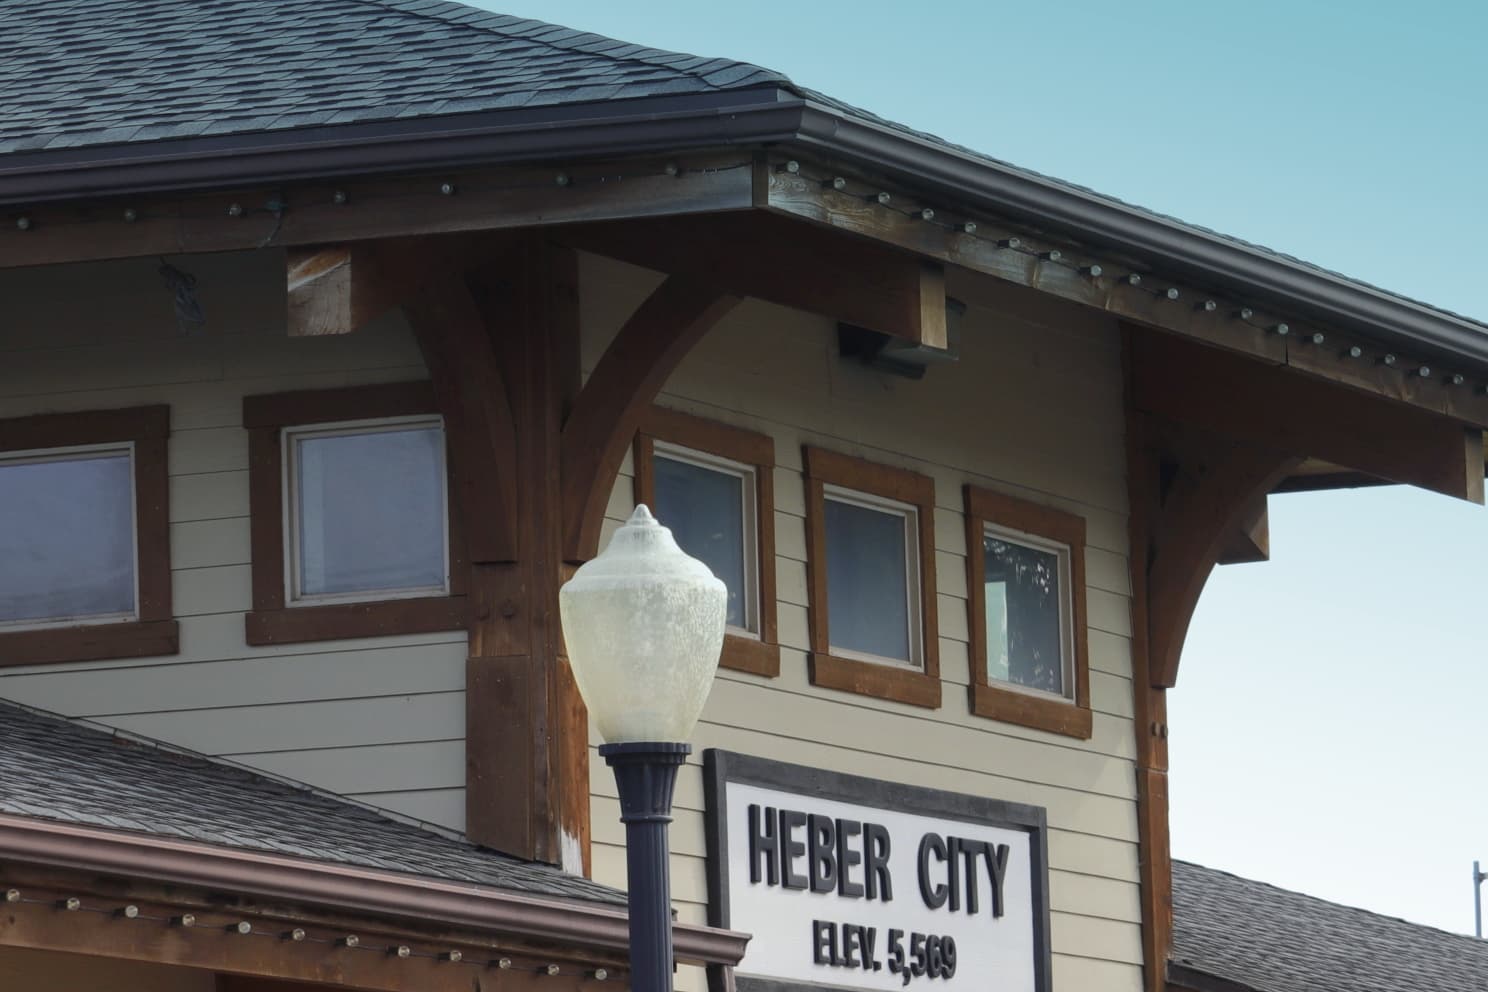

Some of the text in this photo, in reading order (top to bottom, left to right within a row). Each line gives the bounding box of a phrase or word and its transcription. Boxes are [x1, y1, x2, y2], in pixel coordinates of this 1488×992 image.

[748, 804, 1010, 919] HEBER CITY
[812, 919, 957, 986] ELEV. 5,569
